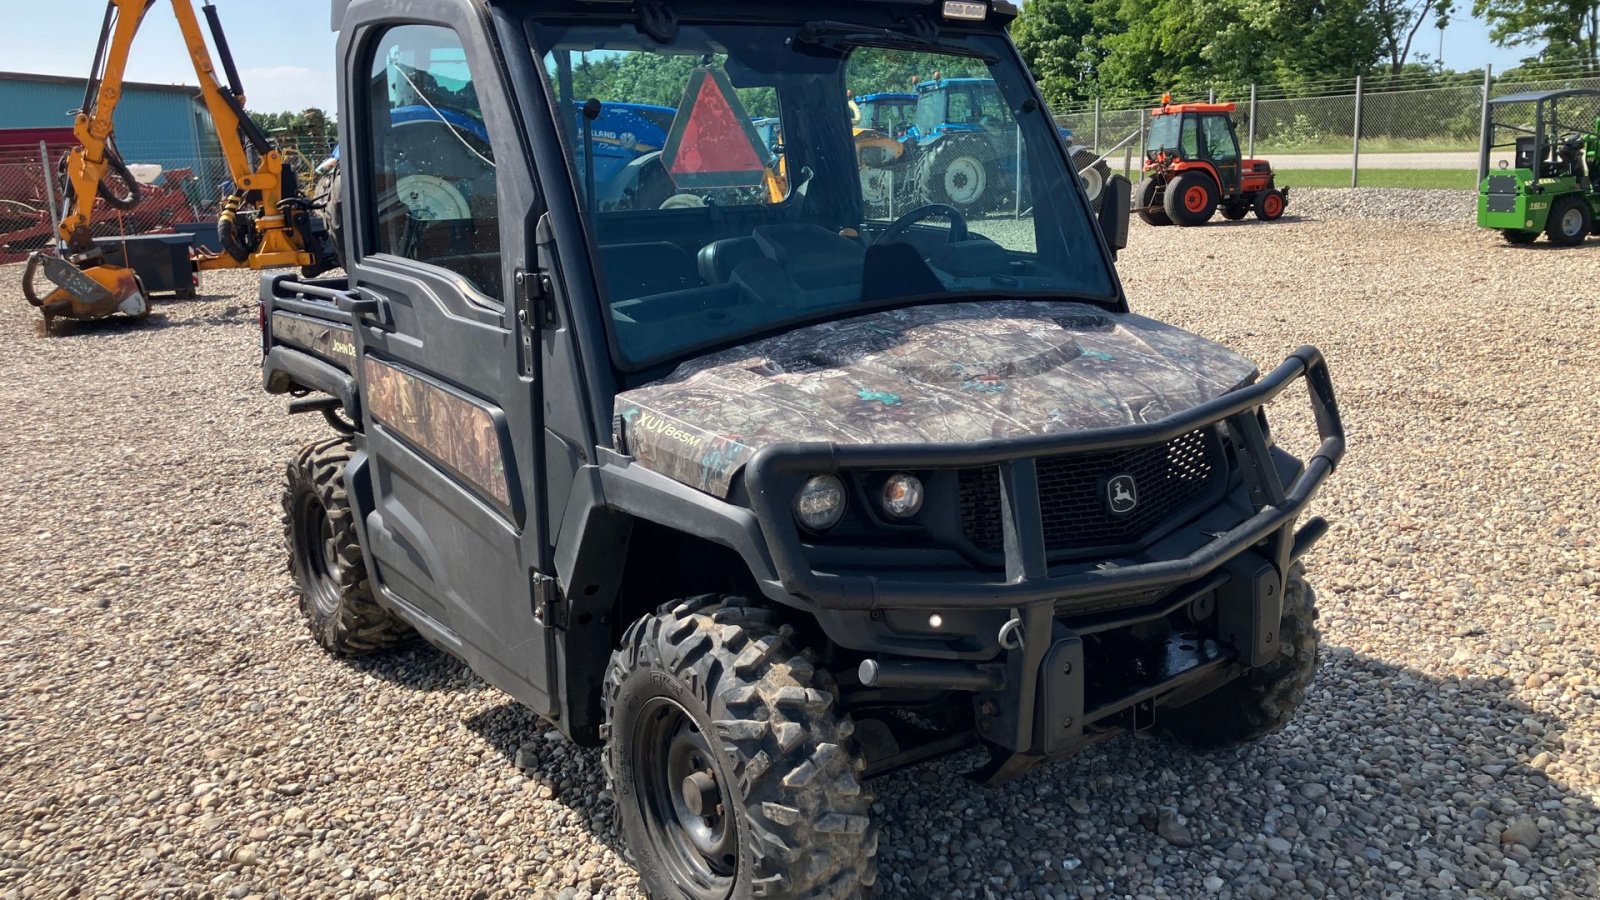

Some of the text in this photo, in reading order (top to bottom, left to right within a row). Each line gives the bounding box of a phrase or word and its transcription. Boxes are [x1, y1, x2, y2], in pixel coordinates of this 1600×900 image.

[578, 128, 617, 139] HLLAND
[332, 339, 348, 354] JOHN
[636, 411, 702, 447] XUV865M
